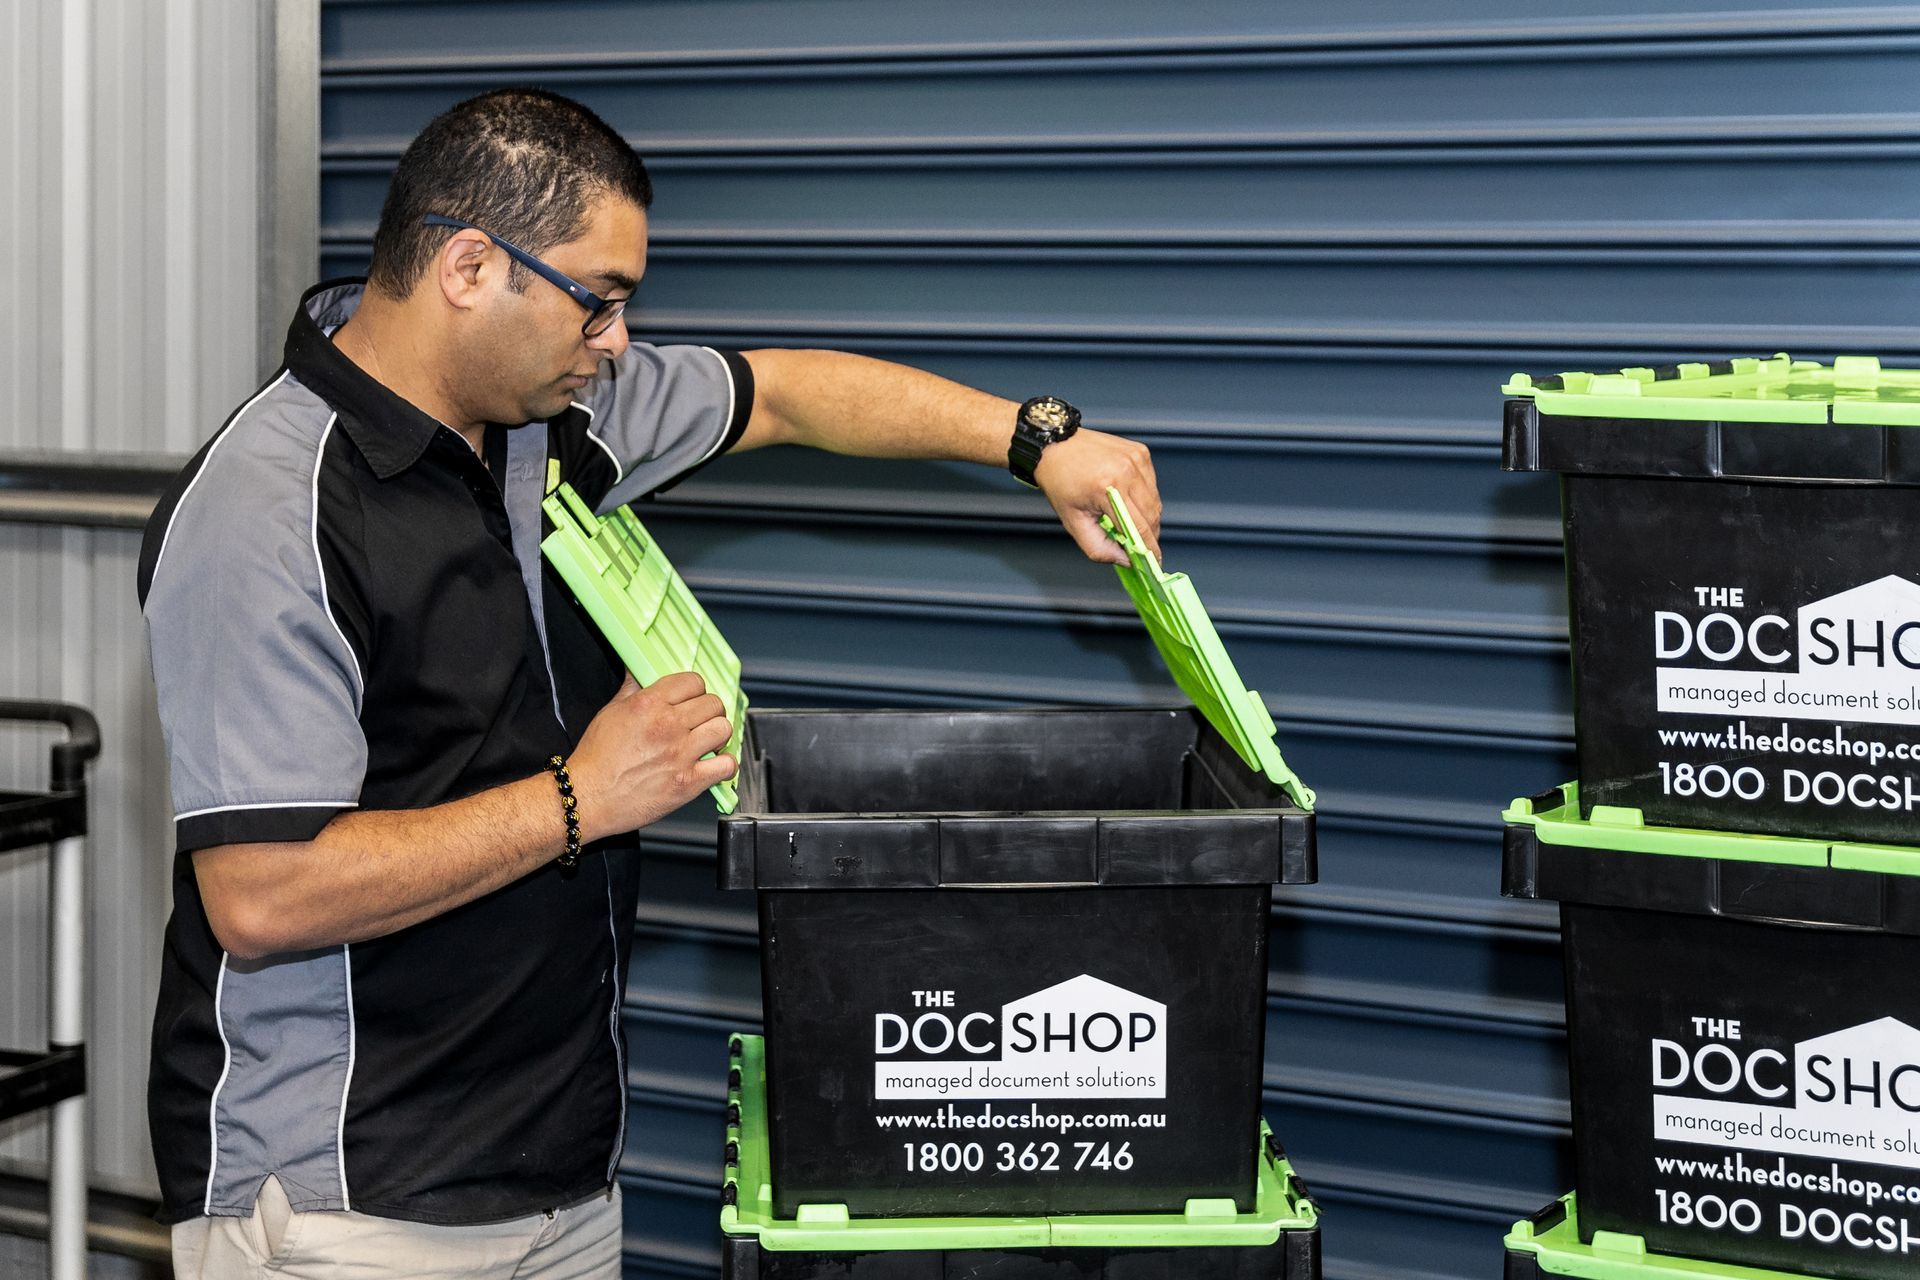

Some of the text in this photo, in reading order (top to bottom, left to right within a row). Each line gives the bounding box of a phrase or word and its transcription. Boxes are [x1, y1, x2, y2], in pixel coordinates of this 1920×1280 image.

[1694, 586, 1744, 607] THE
[1655, 611, 1791, 663] DOC
[1669, 678, 1920, 710] managed document sol
[1659, 762, 1764, 799] 1800
[912, 990, 955, 1007] THE
[875, 1012, 1156, 1054] DOC SHOP
[1692, 1016, 1741, 1039] THE
[886, 1066, 1156, 1093] managed document solutions
[1652, 1038, 1920, 1112] DOC SHO
[876, 1103, 1166, 1134] www.thedocshop.com.au
[1666, 1112, 1763, 1140] managed
[1770, 1114, 1876, 1149] document
[904, 1142, 1134, 1171] 1800 362 746
[1655, 1189, 1761, 1232] 1800
